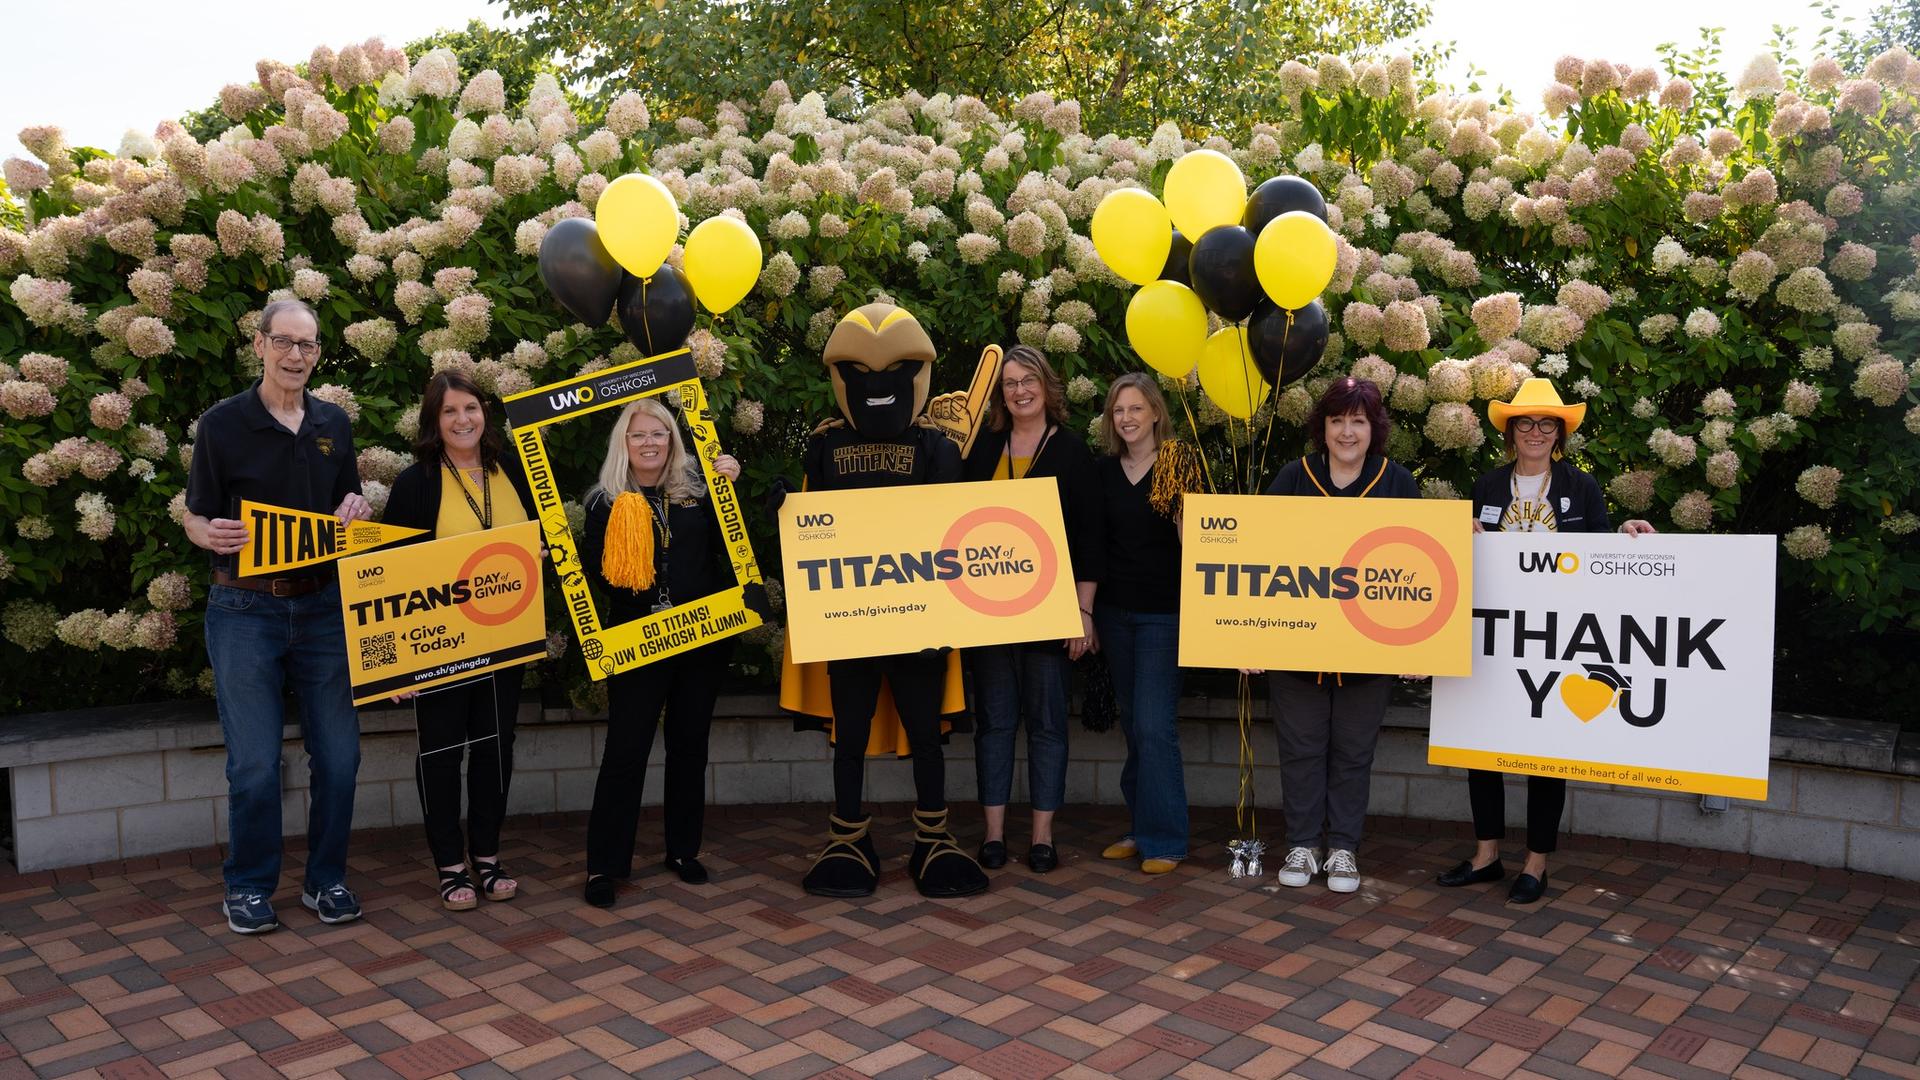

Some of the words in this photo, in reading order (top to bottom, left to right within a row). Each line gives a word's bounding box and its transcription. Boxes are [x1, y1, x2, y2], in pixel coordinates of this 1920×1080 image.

[600, 374, 657, 397] OSHKOSH
[549, 386, 594, 411] UWO
[519, 430, 557, 512] TRADITION
[834, 452, 914, 475] TITANS
[712, 475, 744, 543] SUCCESS
[796, 513, 834, 528] UWO
[1200, 516, 1238, 530] UWO
[250, 509, 337, 568] TITAN
[353, 537, 382, 545] OSHKOSH
[798, 532, 836, 541] OSHKOSH
[1200, 536, 1238, 544] OSHKOSH
[965, 546, 1002, 562] DAY
[1003, 546, 1015, 559] of
[1518, 551, 1580, 575] UWO
[1638, 553, 1675, 561] WISCONSIN
[357, 566, 384, 580] UWO
[797, 549, 964, 591] TITANS
[967, 559, 1034, 578] GIVING
[1364, 567, 1403, 583] DAY
[1403, 572, 1417, 584] of
[1590, 560, 1675, 577] OSHKOSH
[474, 572, 501, 588] DAY
[501, 572, 509, 582] of
[475, 580, 522, 600] GIVING
[1195, 562, 1361, 601] TITANS
[349, 579, 472, 627] TITANS
[1364, 586, 1433, 602] GIVING
[569, 589, 598, 637] PRIDE
[824, 602, 928, 620] uwo.sh/givingday
[409, 624, 447, 641] Give
[642, 622, 661, 640] GO
[662, 605, 711, 633] TITANS!
[1215, 616, 1318, 631] uwo.sh/givingday
[411, 632, 466, 656] Today!
[614, 647, 637, 666] UW
[639, 627, 697, 658] OSHKOSH
[701, 610, 748, 638] ALUMNI
[1472, 608, 1727, 671] THANK
[414, 656, 491, 681] uwo.sh/givingday
[1496, 757, 1538, 771] Students
[1541, 763, 1556, 773] are
[1558, 765, 1568, 774] at
[1571, 765, 1587, 776] the
[1589, 766, 1616, 779] heart
[1619, 770, 1629, 780] of
[1632, 771, 1643, 782] all
[1647, 775, 1662, 784] we
[1665, 774, 1682, 786] do.
